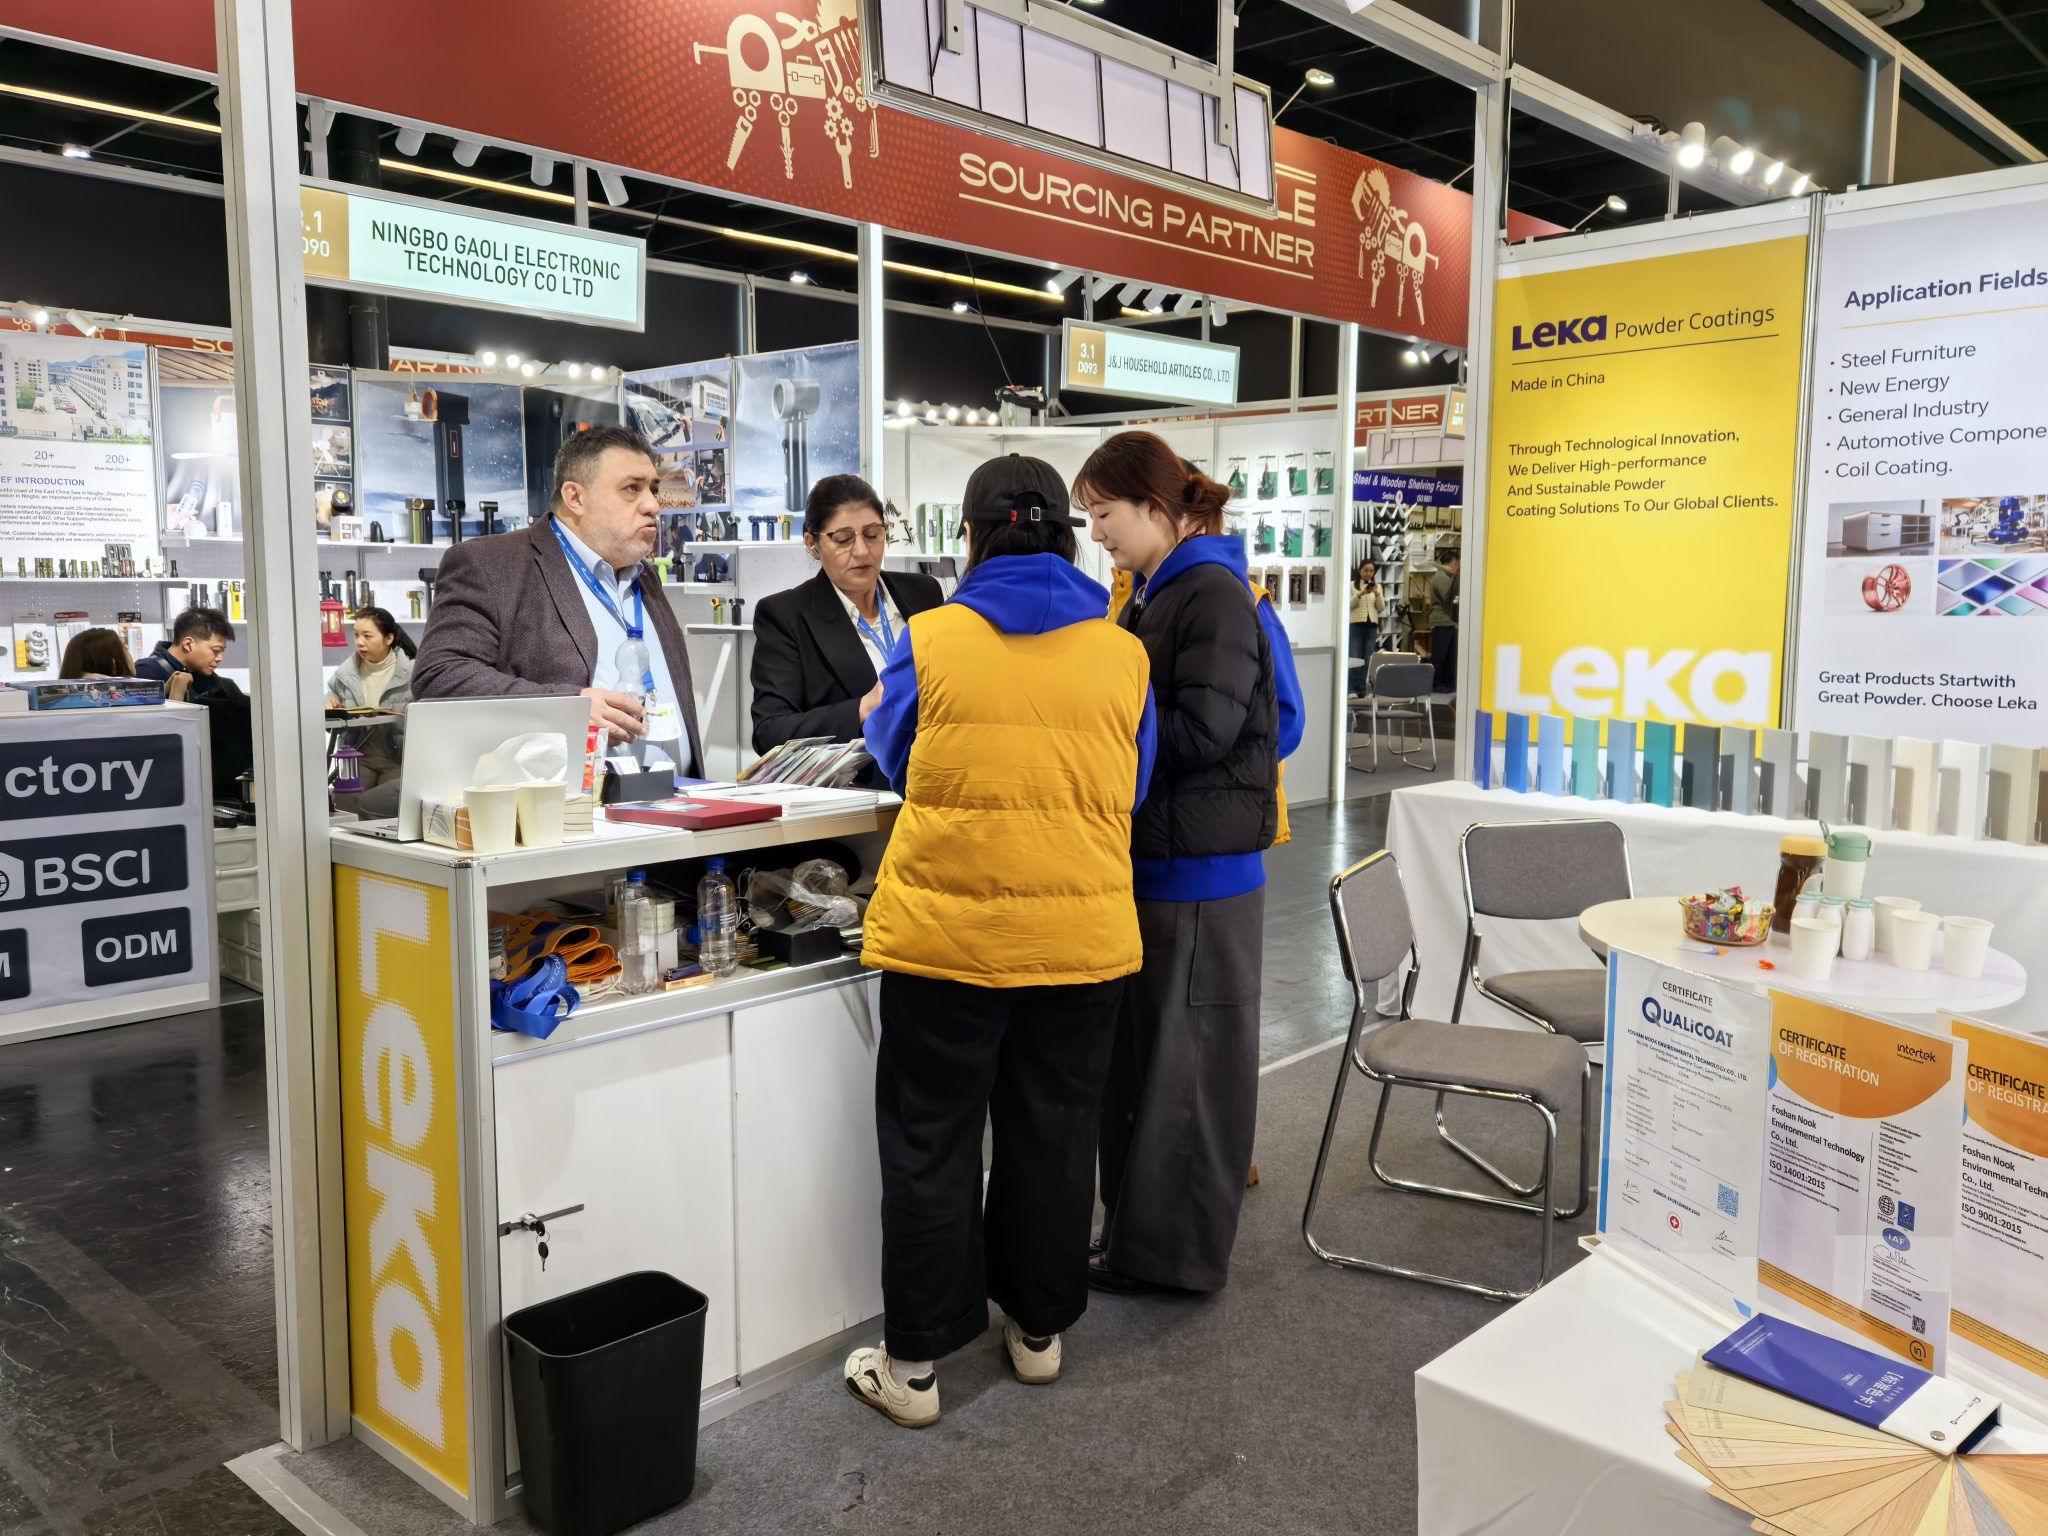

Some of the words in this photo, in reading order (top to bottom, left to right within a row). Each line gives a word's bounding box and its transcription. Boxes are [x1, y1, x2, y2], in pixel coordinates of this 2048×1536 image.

[301, 209, 322, 233] .1
[959, 152, 1153, 230] SOURCING
[1163, 203, 1315, 268] PARTNER
[371, 219, 449, 251] NINGBO
[454, 235, 508, 262] GAOLI
[514, 245, 621, 281] ELECTRONIC
[404, 250, 529, 288] TECHNOLOGY
[534, 271, 557, 292] CO
[562, 277, 594, 298] LTD
[1844, 279, 1972, 311] Application
[1979, 268, 2048, 292] Fields
[1615, 318, 1684, 339] Powder
[1689, 306, 1775, 331] Coatings
[1080, 343, 1095, 360] 3.1
[1841, 350, 1886, 369] Steel
[1892, 345, 1976, 364] Furniture
[1078, 361, 1098, 375] D093
[1107, 355, 1122, 369] J&J
[1123, 356, 1167, 375] HOUSEHOLD
[1169, 363, 1201, 380] ARTICLES
[1203, 367, 1216, 383] CO.,
[1511, 378, 1547, 392] Made
[1551, 376, 1563, 388] in
[1566, 373, 1605, 387] China
[1840, 381, 1880, 396] New
[1886, 375, 1950, 393] Energy
[1838, 403, 1908, 423] General
[1912, 400, 1989, 419] Industry
[1509, 440, 1561, 457] Through
[1565, 434, 1657, 451] Technological
[1660, 429, 1740, 446] Innovation,
[1837, 431, 1944, 451] Automotive
[1949, 426, 2047, 445] Compone
[34, 450, 55, 460] 20+
[105, 454, 131, 464] 200+
[1508, 463, 1528, 476] We
[1532, 461, 1576, 475] Deliver
[1579, 454, 1707, 473] High-performance
[1836, 462, 1870, 478] Coil
[1875, 459, 1953, 477] Coating.
[15, 476, 85, 487] INTRODUCTION
[1353, 473, 1371, 486] Steel
[1381, 475, 1406, 489] Wooden
[1407, 478, 1435, 494] Shelving
[1436, 481, 1460, 495] Factory
[1507, 483, 1533, 497] And
[1536, 480, 1611, 495] Sustainable
[1614, 478, 1666, 492] Powder
[1506, 503, 1556, 519] Coating
[1559, 501, 1619, 515] Solutions
[1623, 500, 1640, 512] To
[1644, 498, 1669, 511] Our
[1673, 495, 1718, 510] Global
[1723, 494, 1778, 509] Clients.
[1818, 670, 1861, 684] Great
[1865, 672, 1935, 686] Products
[1939, 673, 2016, 688] Startwith
[1818, 690, 1860, 704] Great
[1864, 691, 1927, 707] Powder.
[1931, 693, 1993, 709] Choose
[1997, 696, 2038, 710] Leka
[4, 755, 154, 801] ctory
[34, 848, 150, 897] BSCI
[95, 929, 178, 963] ODM
[1662, 981, 1713, 1007] CERTIFICATE
[1779, 1027, 1847, 1061] CERTIFICATE
[1778, 1043, 1793, 1056] OF
[1795, 1050, 1880, 1087] REGISTRATION
[1967, 1063, 2046, 1100] CERTIFICATE
[1967, 1078, 1985, 1094] OF
[1988, 1085, 2048, 1115] REGISTRA
[1772, 1104, 1796, 1121] Foshan
[1797, 1115, 1817, 1129] Nook
[1770, 1130, 1784, 1144] Co.,
[1785, 1136, 1799, 1149] Ltd.
[1771, 1117, 1822, 1145] Environmental
[1823, 1138, 1865, 1164] Technology
[1962, 1144, 1991, 1163] Foshan
[1992, 1155, 2015, 1172] Nook
[1769, 1159, 1782, 1171] ISO
[1783, 1165, 1826, 1190] 14001:2015
[1962, 1158, 2022, 1188] Environmental
[2023, 1181, 2048, 1199] Techn
[1962, 1172, 1977, 1186] Co.,
[1979, 1179, 1995, 1192] Ltd.
[1961, 1202, 1976, 1215] ISO
[1978, 1209, 2022, 1235] 9001:2015
[1888, 1233, 1905, 1247] IAF
